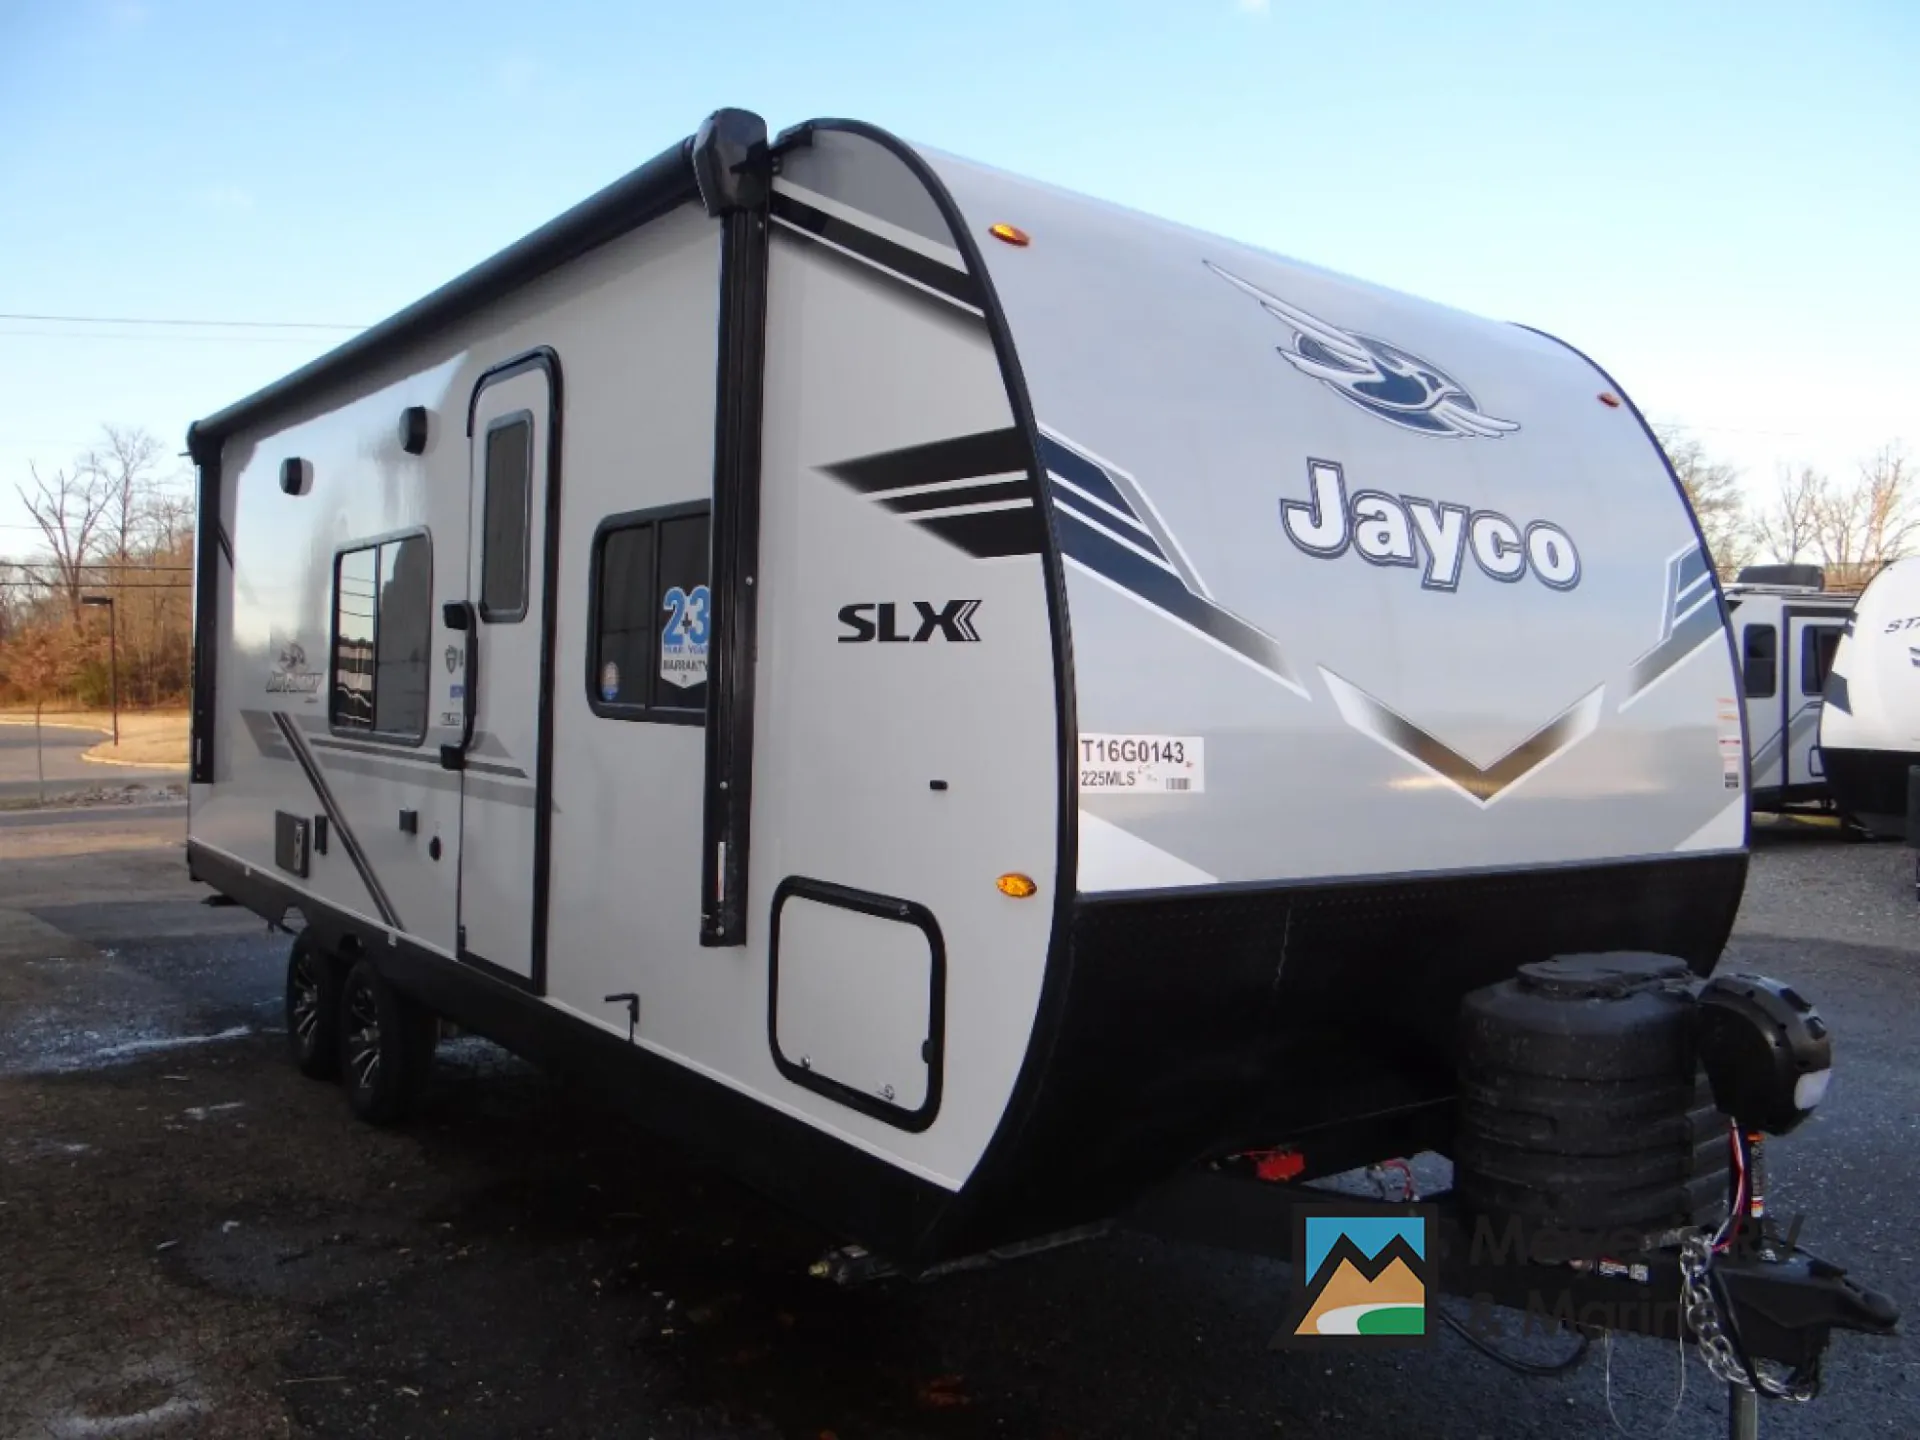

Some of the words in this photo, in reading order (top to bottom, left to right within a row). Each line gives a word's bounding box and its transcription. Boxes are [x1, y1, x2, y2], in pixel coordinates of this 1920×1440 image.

[1280, 456, 1582, 593] Jayco
[838, 599, 983, 643] SLX
[1081, 739, 1184, 764] T16G0143
[1081, 769, 1136, 787] 225MLS
